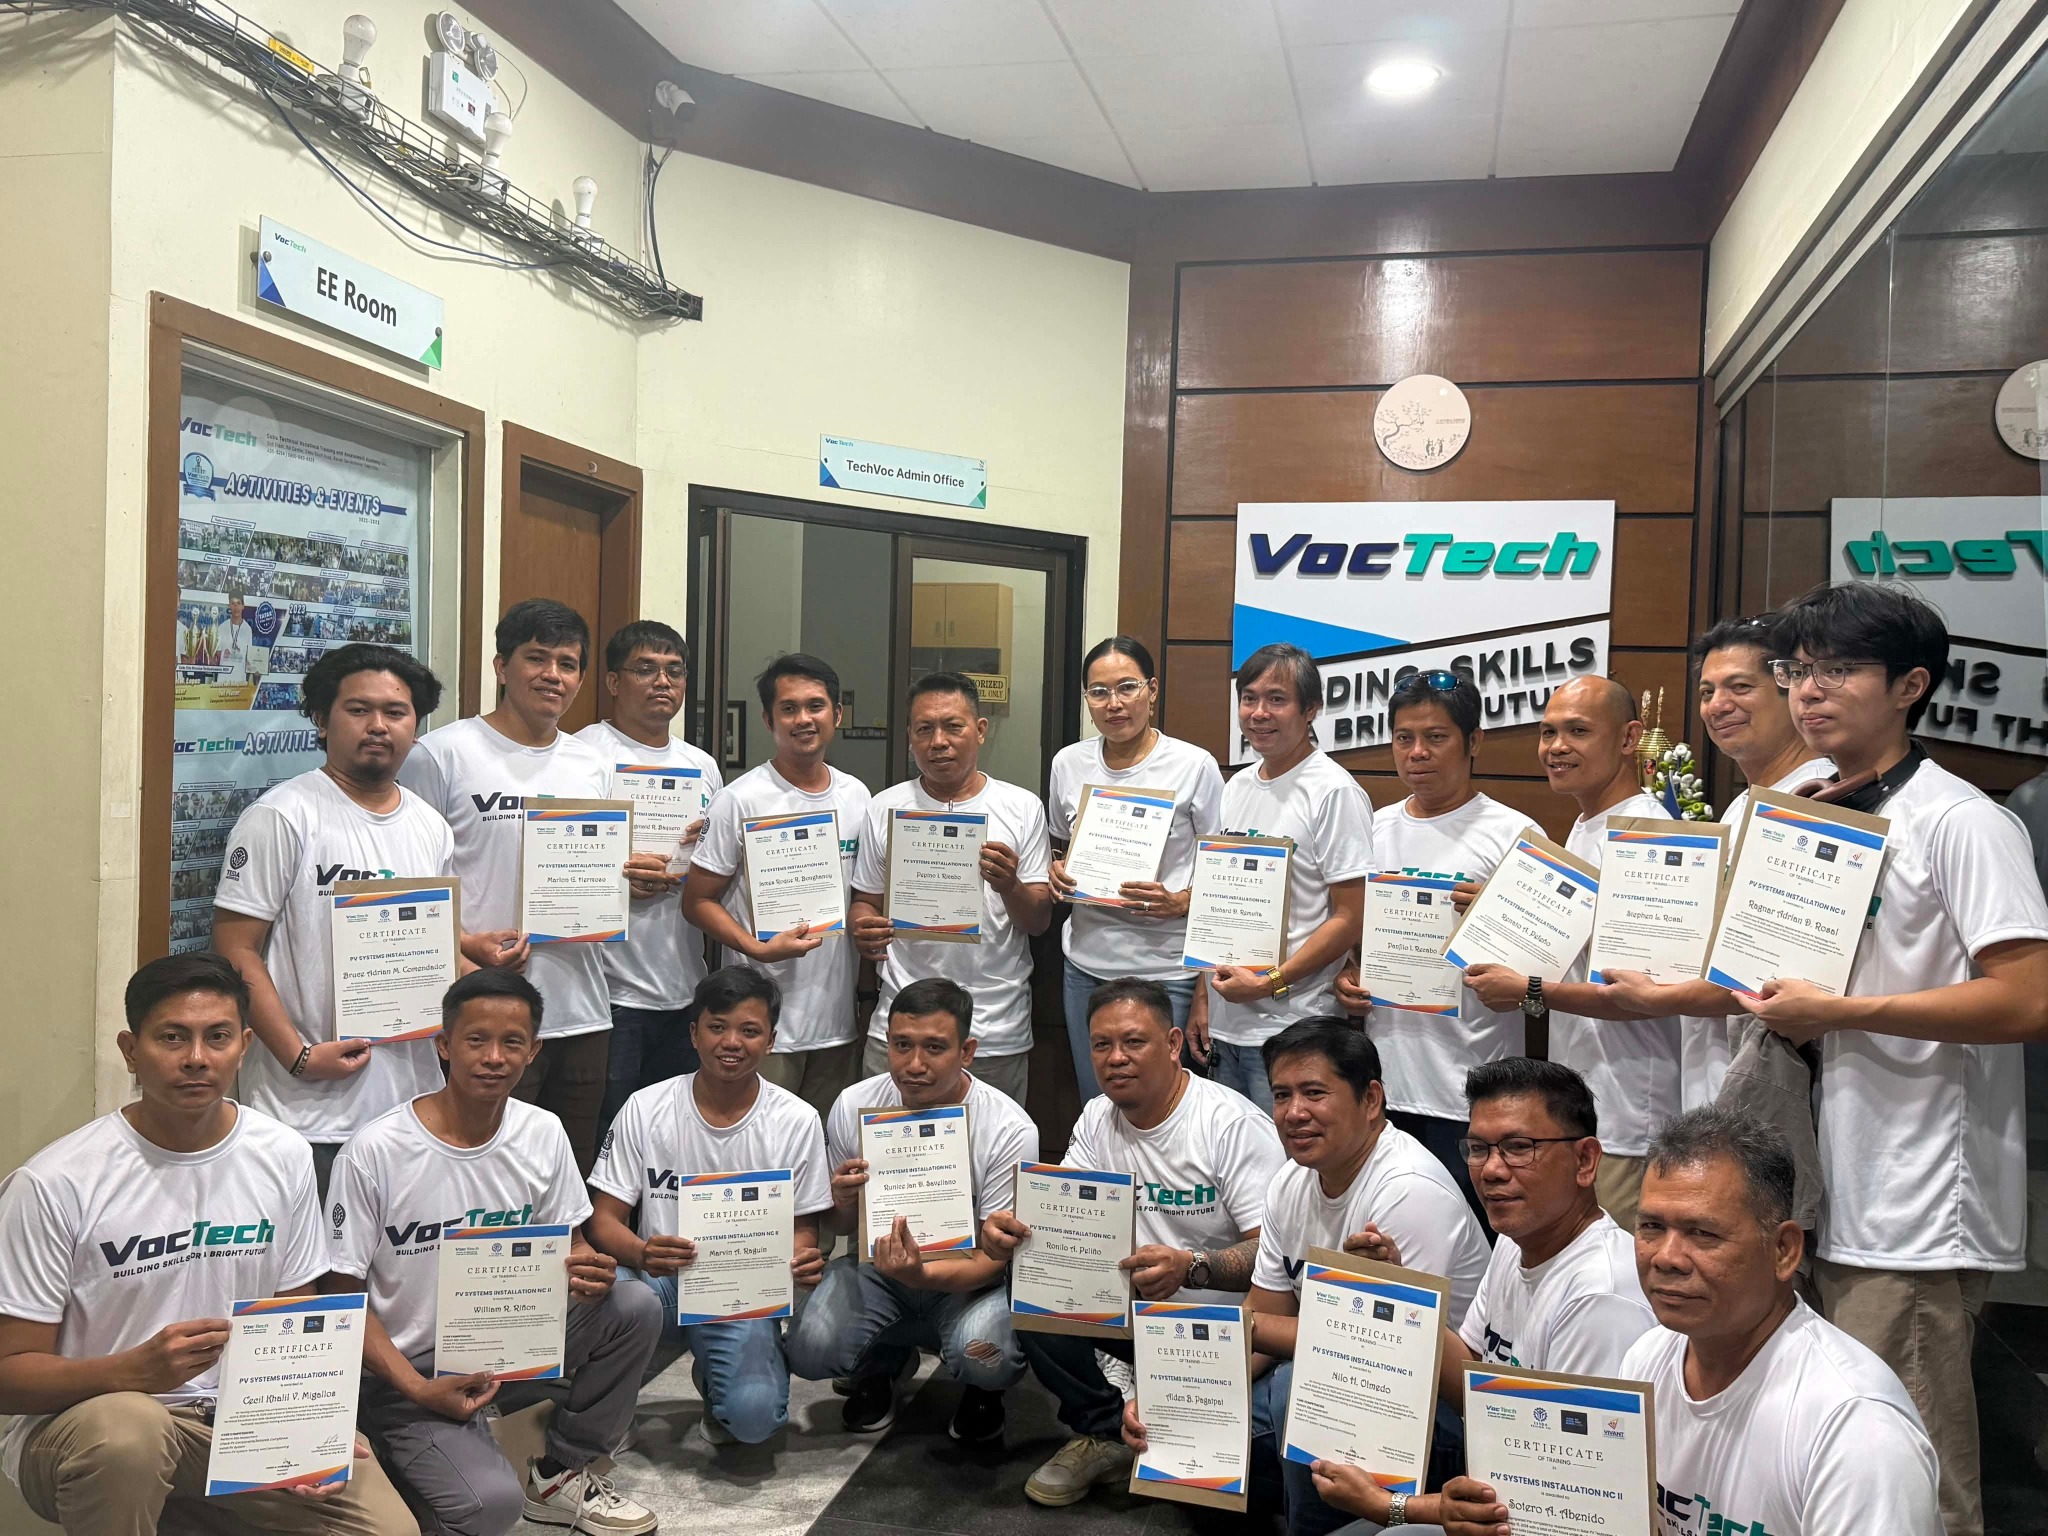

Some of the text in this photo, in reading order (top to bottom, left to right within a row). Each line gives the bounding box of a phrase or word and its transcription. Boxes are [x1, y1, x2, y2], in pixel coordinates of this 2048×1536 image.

[275, 232, 307, 253] VocTech
[316, 266, 398, 327] EE Room
[180, 417, 257, 447] VocTech
[825, 437, 854, 448] VocTech
[846, 459, 965, 489] TechVoc Admin Office
[223, 472, 382, 516] ACTIVITIES & EVENTS
[1249, 532, 1601, 576] VocTech
[288, 603, 307, 616] 2023
[1450, 637, 1596, 682] SKILLS
[975, 679, 1004, 689] ORIZED
[988, 690, 1004, 698] ONLY
[173, 729, 318, 756] ocTech ACTIVITIE
[482, 814, 516, 822] BUILDING
[912, 841, 965, 850] CERTIFICATE
[1624, 870, 1690, 883] CERTIFICATE
[1767, 856, 1841, 885] CERTIFICATE
[1212, 874, 1264, 885] CERTIFICATE
[1516, 880, 1573, 916] CERTIFICATE
[1645, 897, 1685, 905] INSTALLATION
[1758, 883, 1786, 896] SYSTEMS
[1785, 892, 1830, 911] INSTALLATION
[1829, 905, 1841, 914] NC
[1383, 908, 1440, 920] CERTIFICATE
[1748, 899, 1776, 915] Ragnar
[1776, 910, 1803, 925] Adrian
[1815, 921, 1839, 936] Rosal
[359, 927, 427, 940] CERTIFICATE
[885, 1143, 945, 1155] CERTIFICATE
[703, 1208, 768, 1220] CERTIFICATE
[1040, 1202, 1106, 1217] CERTIFICATE
[1186, 1206, 1215, 1216] FUTURE
[1038, 1225, 1063, 1234] SYSTEMS
[1063, 1229, 1102, 1239] INSTALLATION
[99, 1218, 276, 1268] VocTech
[395, 1244, 435, 1256] BUILDING
[709, 1249, 733, 1257] Marvin
[113, 1262, 160, 1279] BUILDING
[162, 1255, 191, 1268] SKILLS
[209, 1249, 242, 1258] BRIGHT
[467, 1264, 541, 1275] CERTIFICATE
[493, 1288, 537, 1296] INSTALLATION
[473, 1306, 502, 1314] William
[1326, 1318, 1402, 1344] CERTIFICATE
[254, 1342, 333, 1356] CERTIFICATE
[1157, 1347, 1220, 1359] CERTIFICATE
[1312, 1346, 1322, 1354] PV
[1321, 1348, 1350, 1361] SYSTEMS
[1350, 1356, 1397, 1373] INSTALLATION
[1397, 1367, 1408, 1376] NC
[250, 1375, 281, 1384] SYSTEMS
[281, 1371, 328, 1381] INSTALLATION
[1158, 1374, 1182, 1382] SYSTEMS
[1182, 1376, 1219, 1385] INSTALLATION
[1360, 1379, 1391, 1395] Olmedo
[242, 1395, 264, 1406] Cecil
[266, 1393, 290, 1404] Khalil
[1485, 1404, 1517, 1415] VocTech
[1504, 1437, 1604, 1462] CERTIFICATE
[1546, 1456, 1572, 1466] TRAINING
[1490, 1471, 1623, 1500] PV SYSTEMS INSTALLATION NC II
[1508, 1498, 1543, 1514] Sotero
[1559, 1508, 1605, 1525] Abenido
